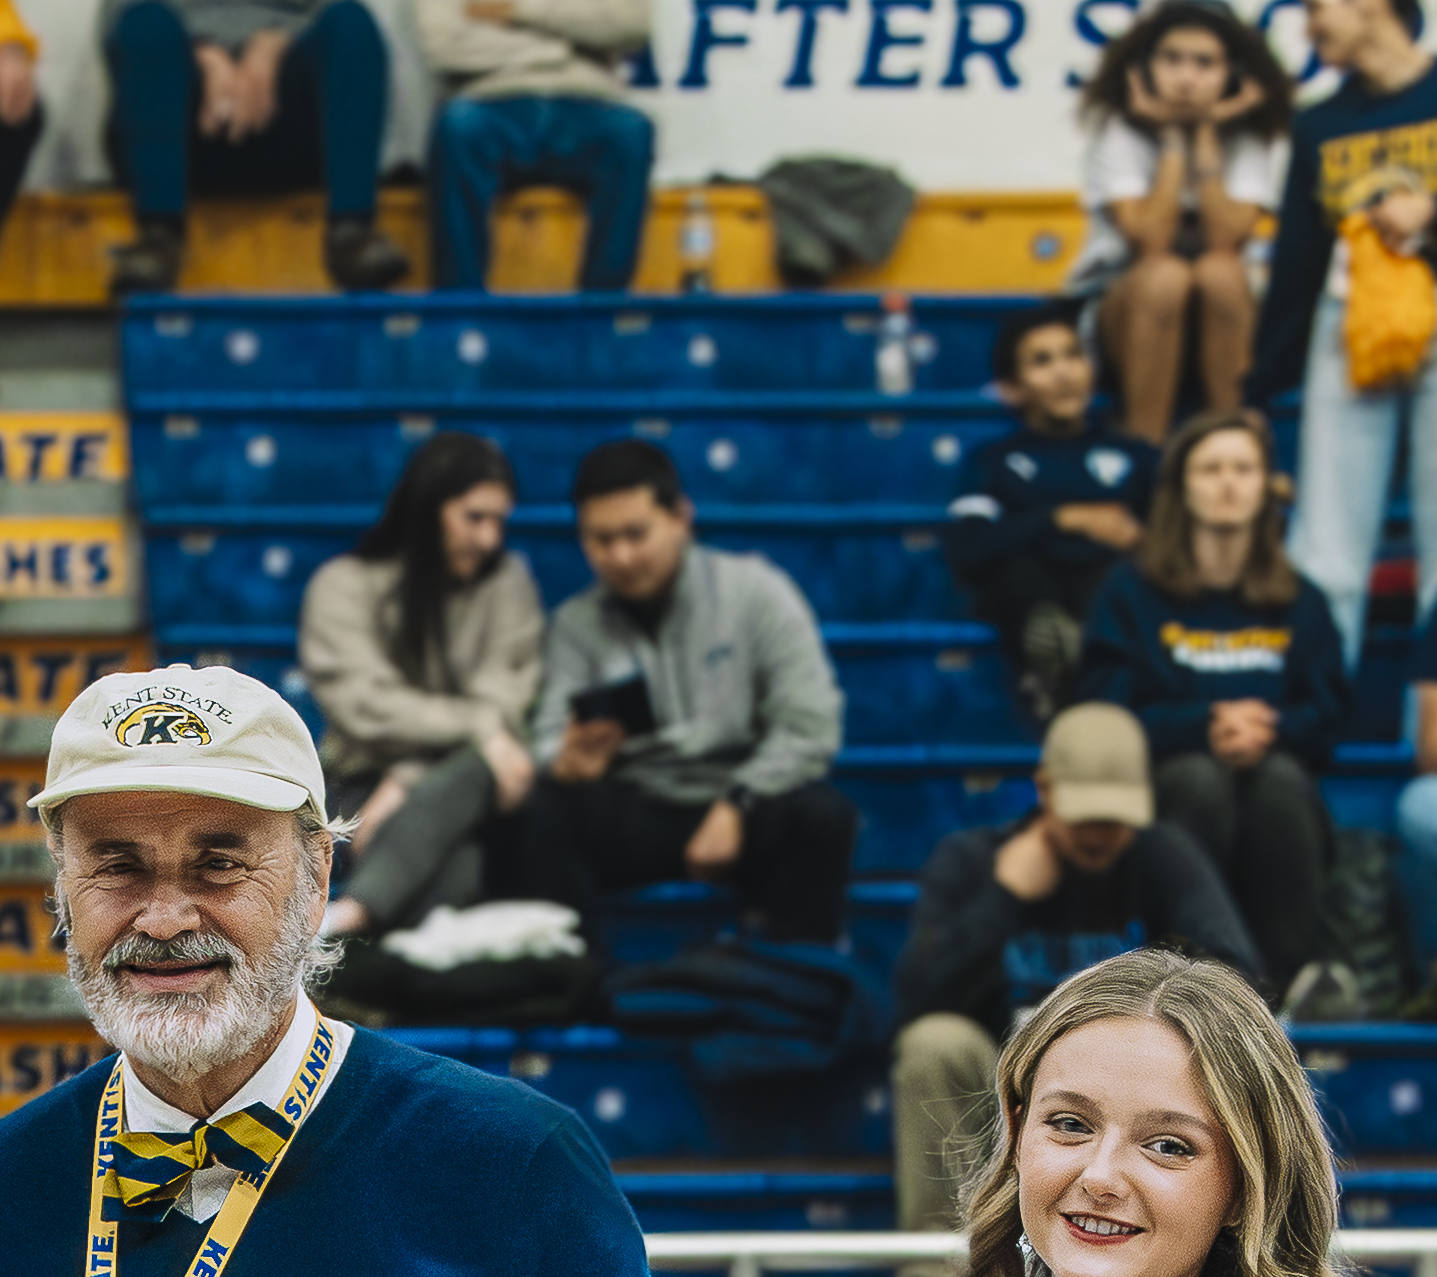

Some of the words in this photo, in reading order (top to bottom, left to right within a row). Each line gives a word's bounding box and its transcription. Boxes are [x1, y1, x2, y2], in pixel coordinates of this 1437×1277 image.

[101, 686, 158, 730] KENT
[162, 685, 233, 725] STATE
[137, 715, 185, 746] K
[299, 1020, 334, 1098] KENT
